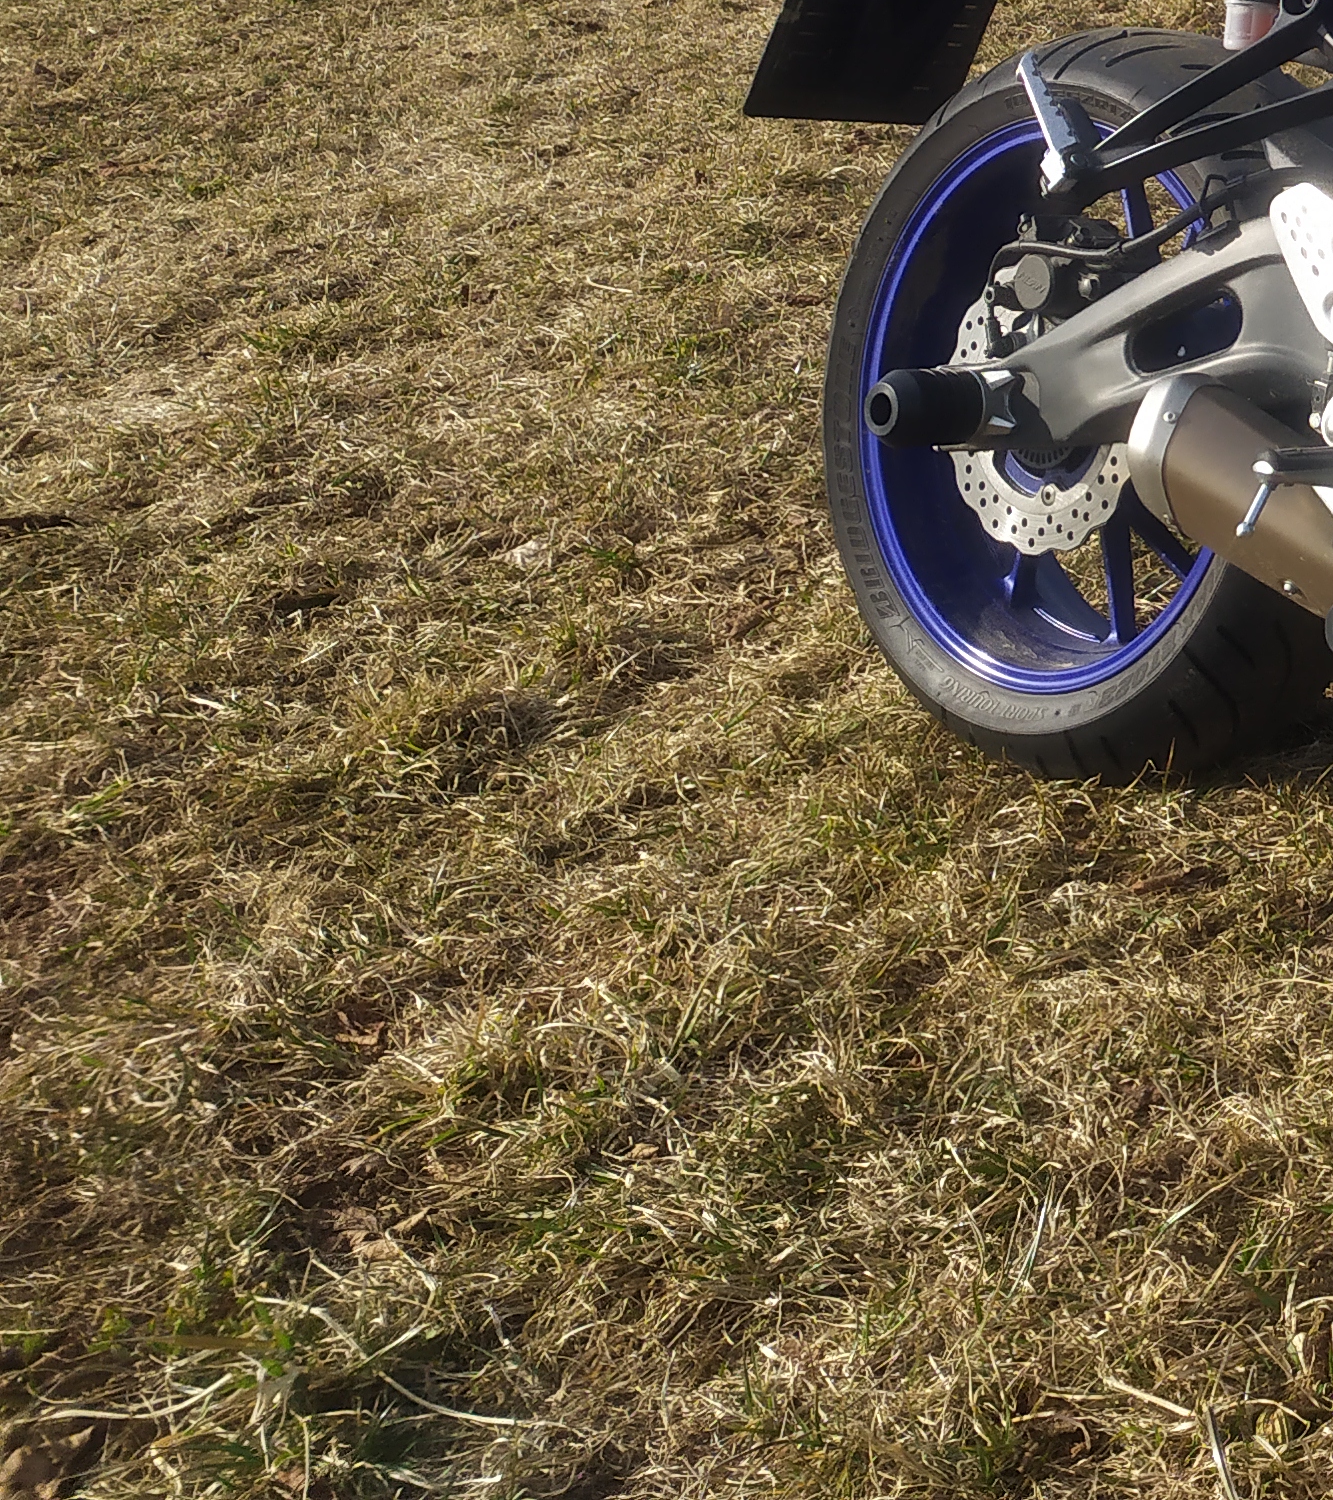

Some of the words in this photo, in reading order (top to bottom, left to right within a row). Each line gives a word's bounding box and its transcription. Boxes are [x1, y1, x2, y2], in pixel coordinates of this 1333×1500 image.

[832, 338, 901, 620] BRIDGESTONE
[938, 675, 1001, 714] TOURING
[999, 703, 1050, 722] SPORT
